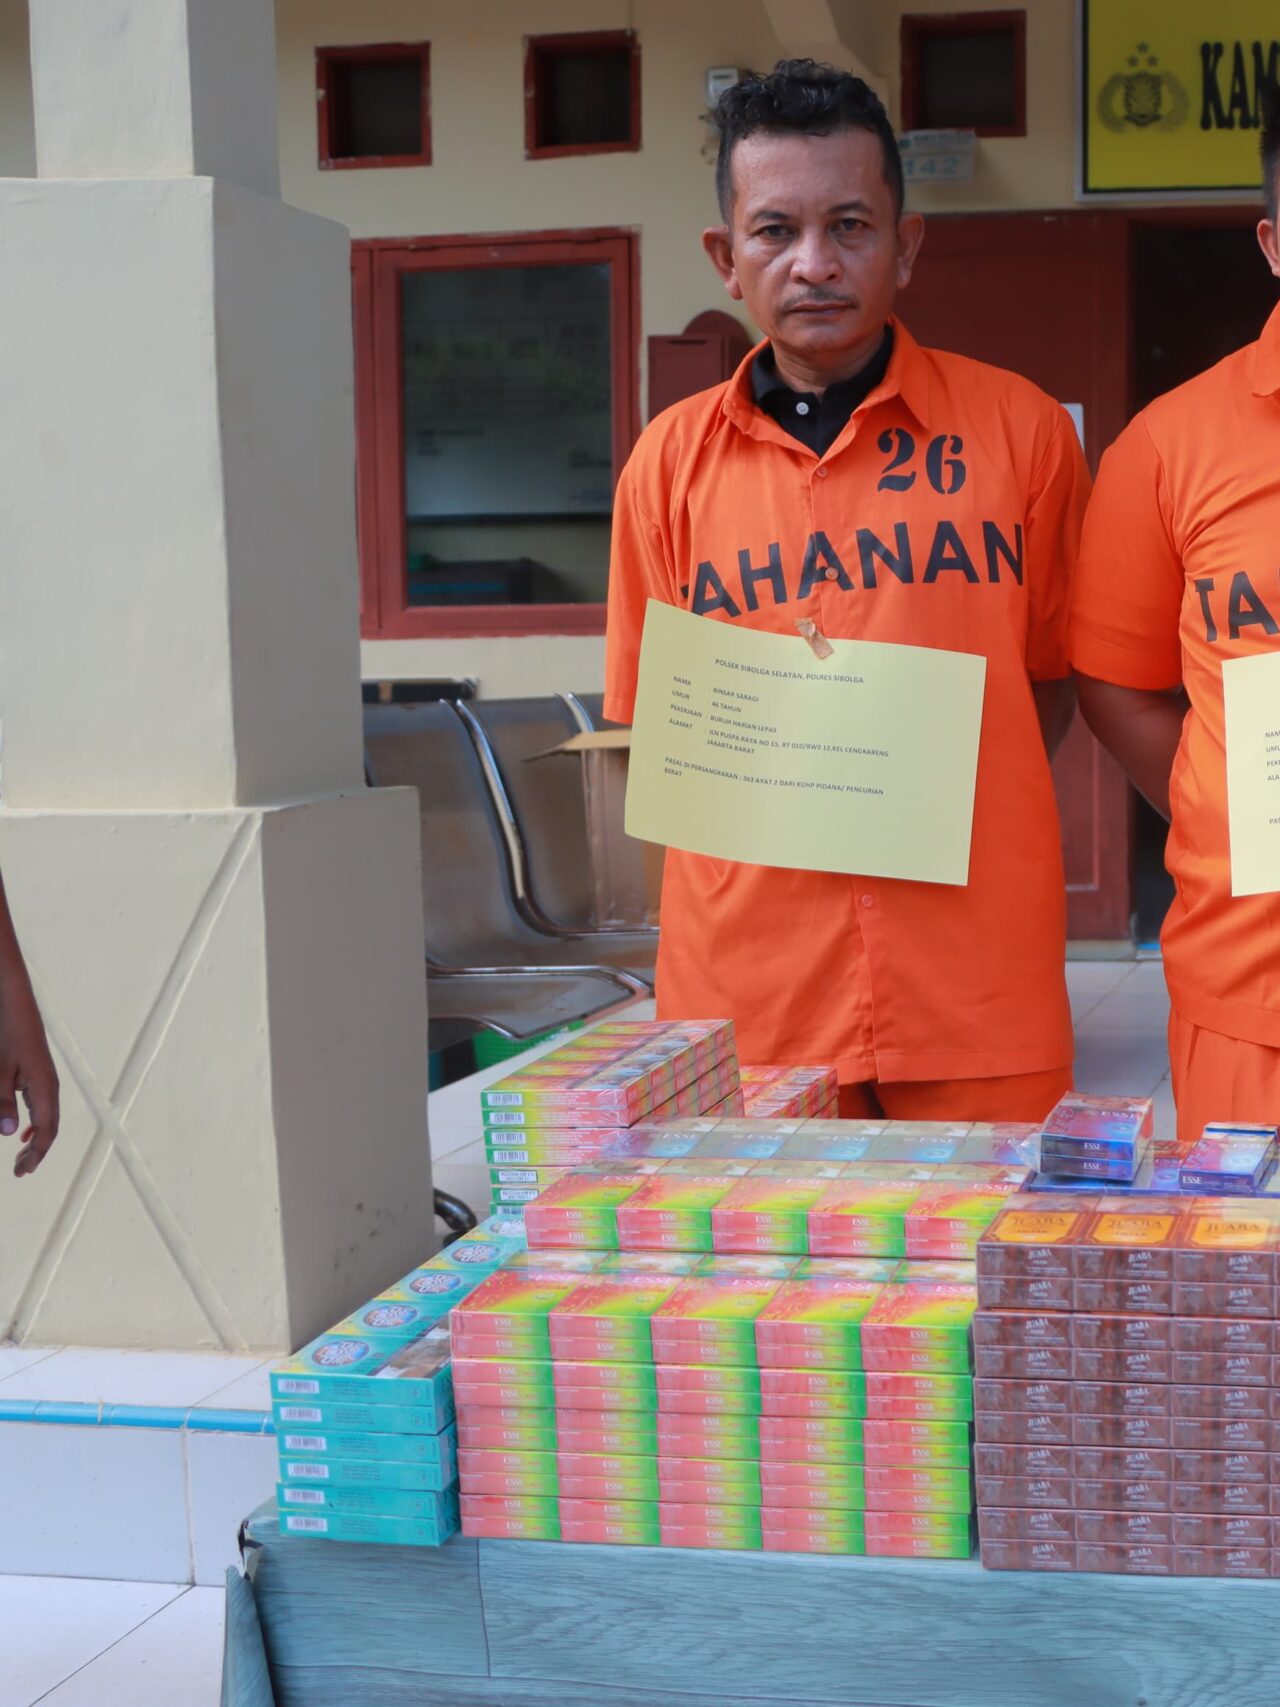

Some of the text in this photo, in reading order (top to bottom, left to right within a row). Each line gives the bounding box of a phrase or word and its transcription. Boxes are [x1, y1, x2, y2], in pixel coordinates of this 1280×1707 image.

[877, 427, 967, 495] 26
[680, 521, 1024, 618] AHANAN
[673, 676, 692, 687] NAMA
[715, 658, 739, 671] POLSEK
[741, 664, 770, 676] SIBOLGA
[834, 675, 864, 684] SIBOLGA
[671, 690, 691, 700] UMUR
[720, 703, 742, 713] TAHUN
[670, 704, 778, 734] PEKERJAAN BURUH HARIAN LEPAS
[668, 718, 693, 730] ALAMAT
[720, 731, 740, 742] PUSPA
[741, 736, 758, 745] RAYA
[706, 739, 755, 755] JAKARTA BARAT
[664, 767, 683, 778] BERAT
[664, 756, 683, 767] PASAL
[683, 761, 691, 770] DI
[690, 764, 739, 780] PERSANGKAKAN
[755, 778, 772, 786] AYAT
[774, 779, 778, 787] 2
[779, 780, 796, 788] DARI
[796, 781, 815, 789] KUHP
[846, 786, 884, 796] PENCURIAN
[1084, 1142, 1100, 1150] ESSE
[1083, 1162, 1099, 1170] ESSE
[1182, 1175, 1202, 1184] ESSE
